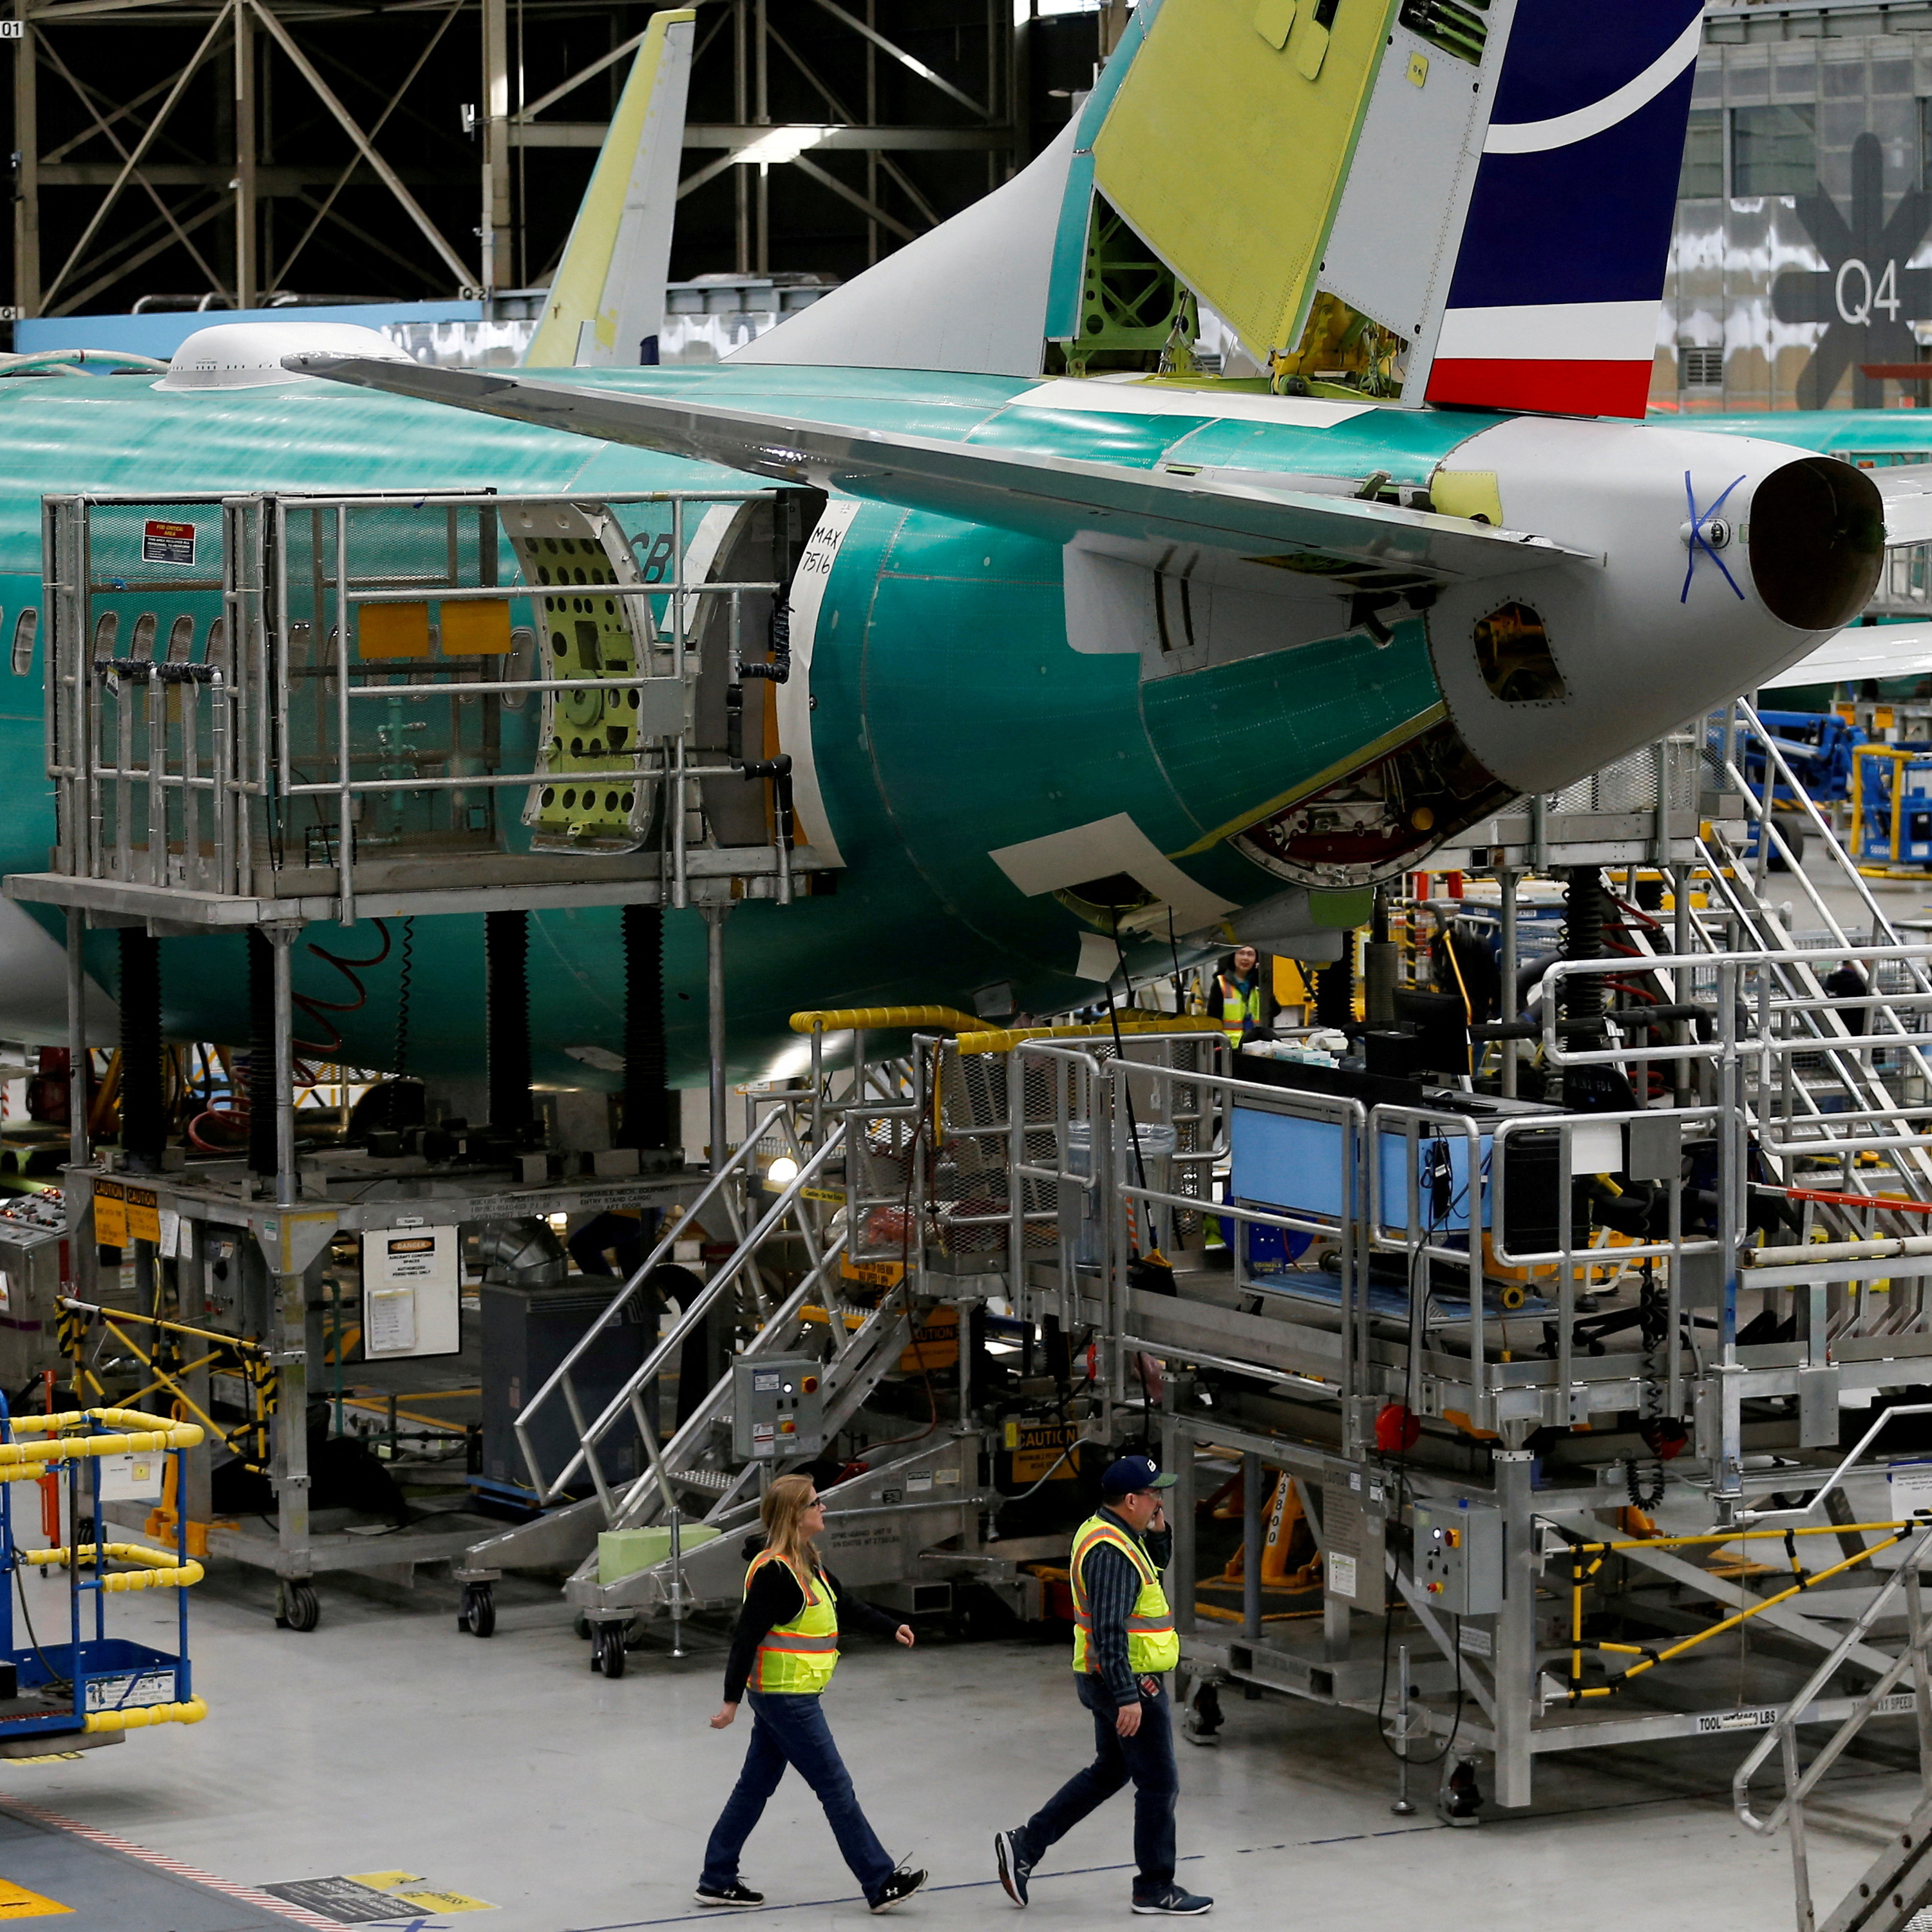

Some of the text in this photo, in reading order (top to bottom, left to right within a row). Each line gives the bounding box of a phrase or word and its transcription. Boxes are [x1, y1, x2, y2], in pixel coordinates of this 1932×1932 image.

[1835, 258, 1901, 328] Q4
[811, 526, 842, 550] MAX
[802, 551, 831, 574] 7516
[95, 1180, 123, 1198] CAUTION
[128, 1189, 156, 1206] CAUTION
[580, 1189, 614, 1198] PORTABLE
[914, 1327, 954, 1341] UTION
[1269, 1473, 1289, 1542] 3800
[1891, 1695, 1913, 1709] SPEED
[1700, 1716, 1721, 1731] TOOL
[1759, 1710, 1776, 1725] LBS
